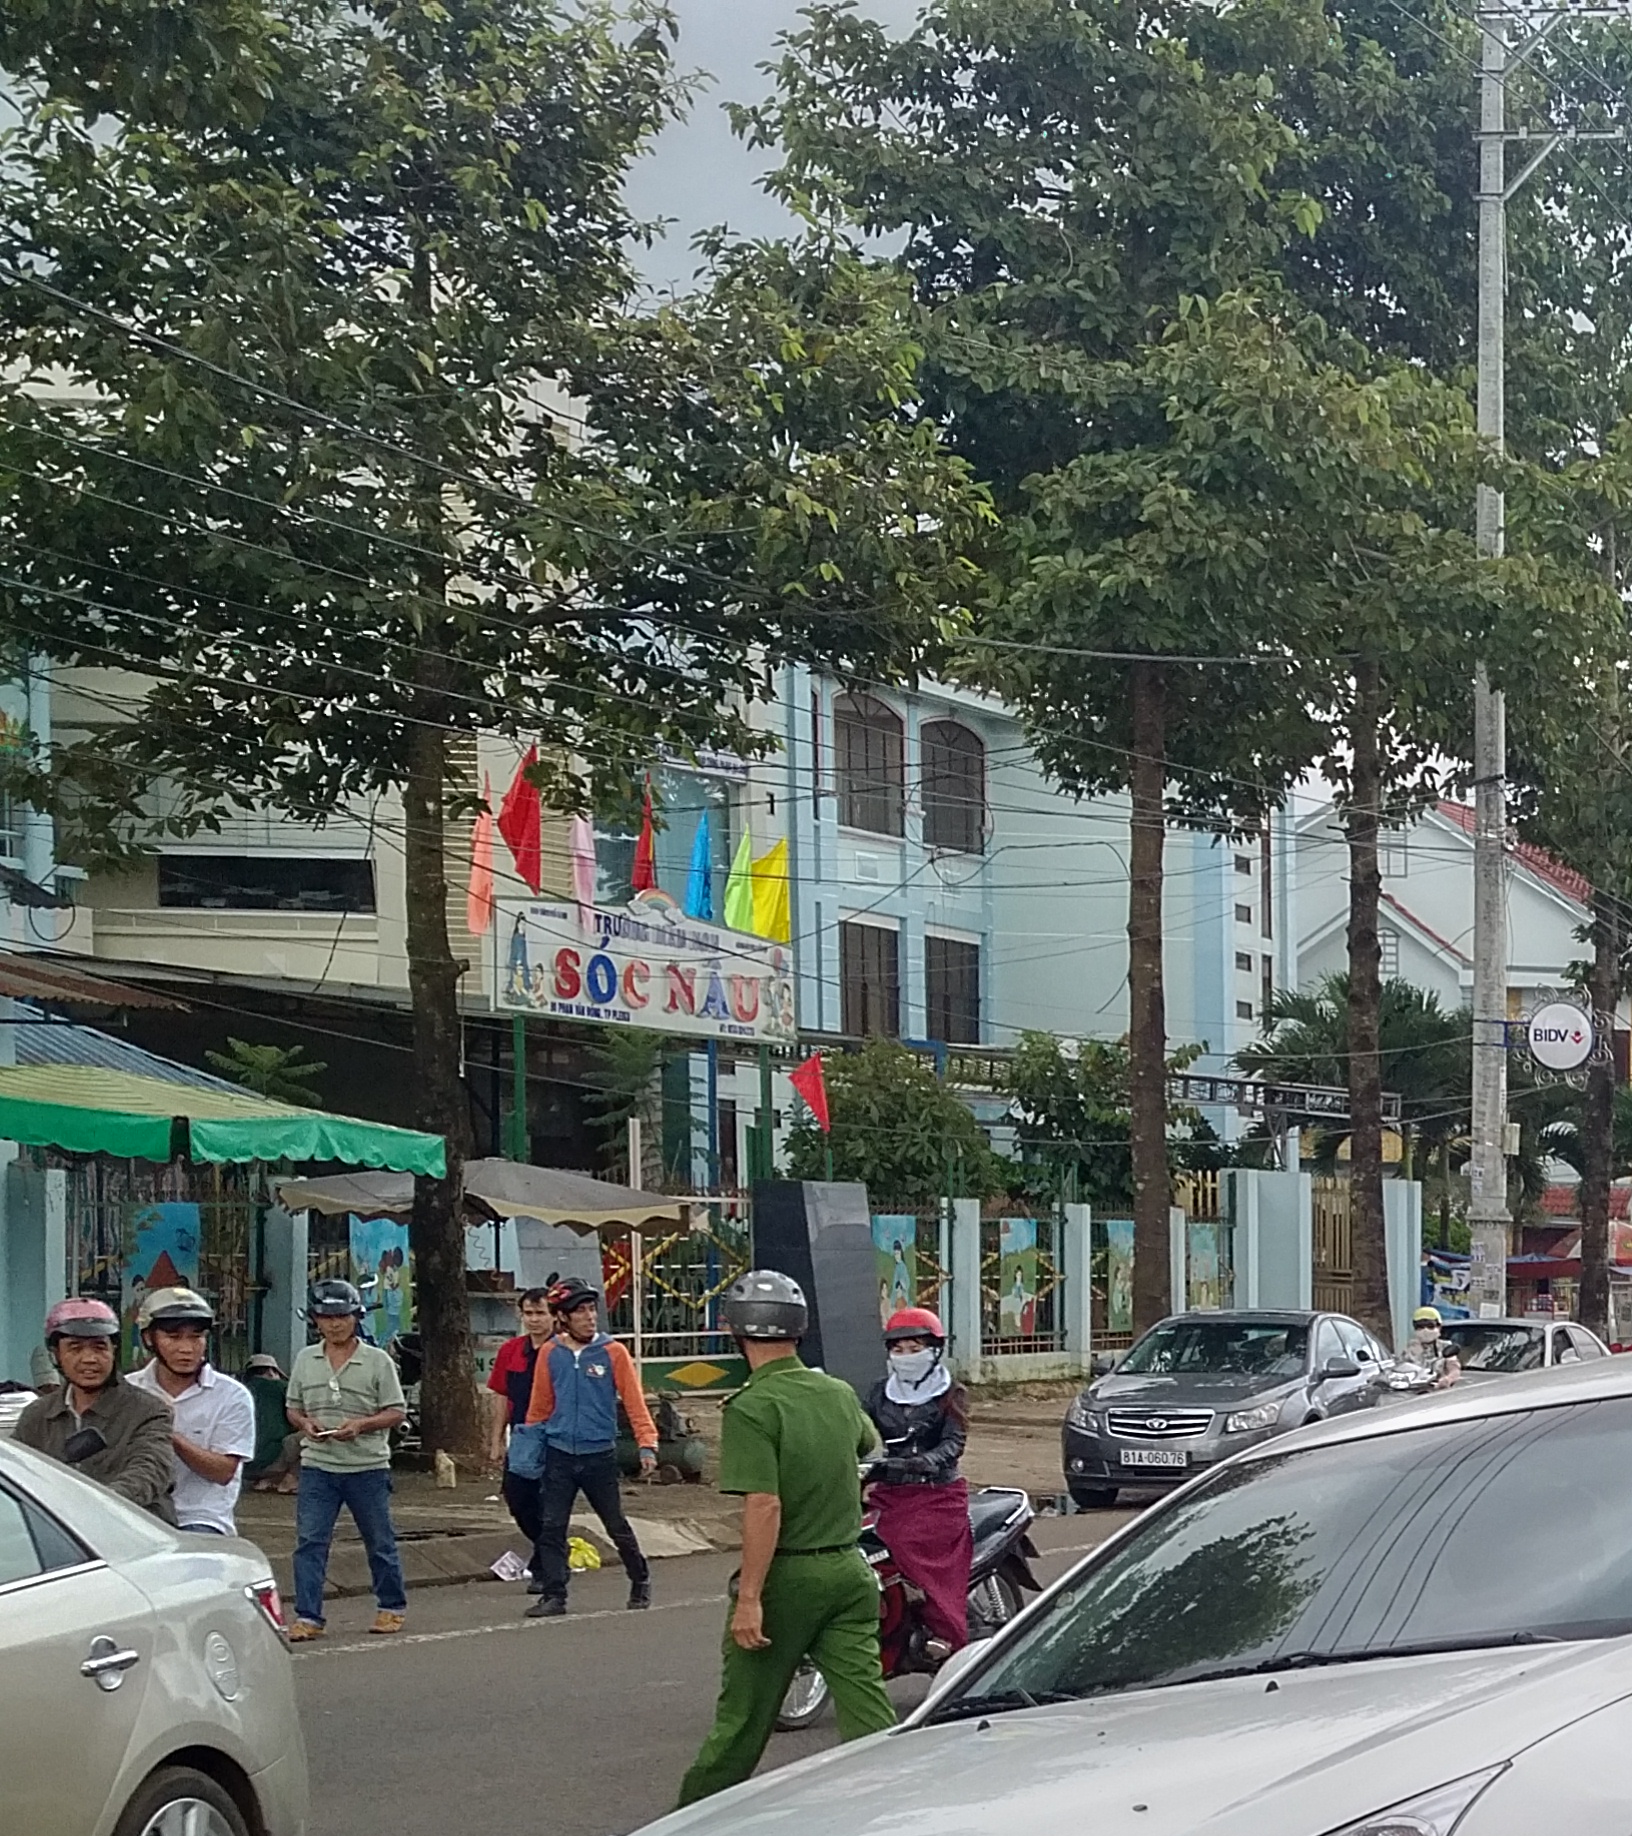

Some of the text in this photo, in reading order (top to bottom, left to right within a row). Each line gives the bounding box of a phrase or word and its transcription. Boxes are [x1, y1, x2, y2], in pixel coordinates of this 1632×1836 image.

[554, 937, 761, 1023] SÓC NÂU
[1533, 1029, 1569, 1042] BIDV
[1123, 1451, 1185, 1465] 81A-060.76
